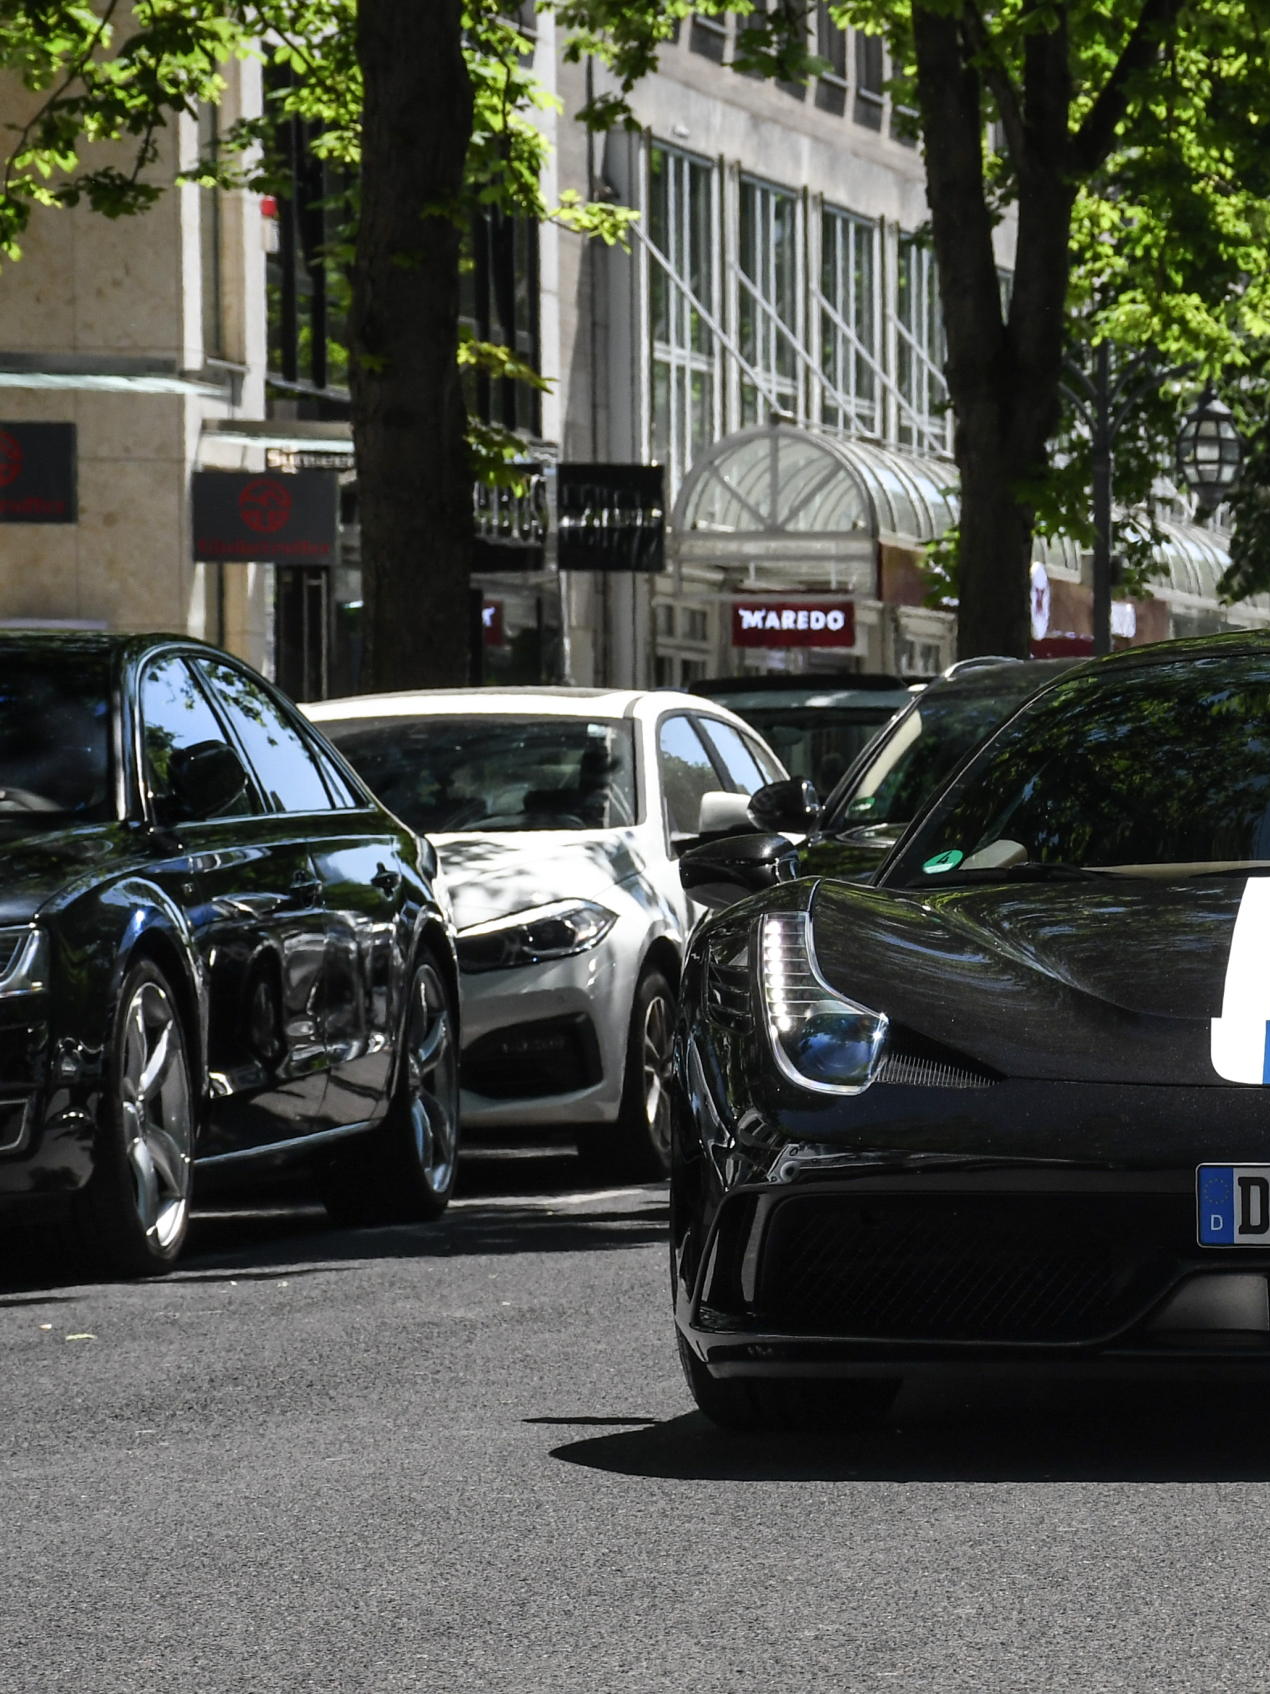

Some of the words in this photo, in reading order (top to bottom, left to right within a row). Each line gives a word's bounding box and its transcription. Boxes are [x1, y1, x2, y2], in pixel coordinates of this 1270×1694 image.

[198, 538, 331, 556] Globetrotter
[738, 608, 846, 631] MAREDO
[936, 851, 953, 864] 4
[1238, 1177, 1270, 1235] D
[1210, 1214, 1223, 1231] D
